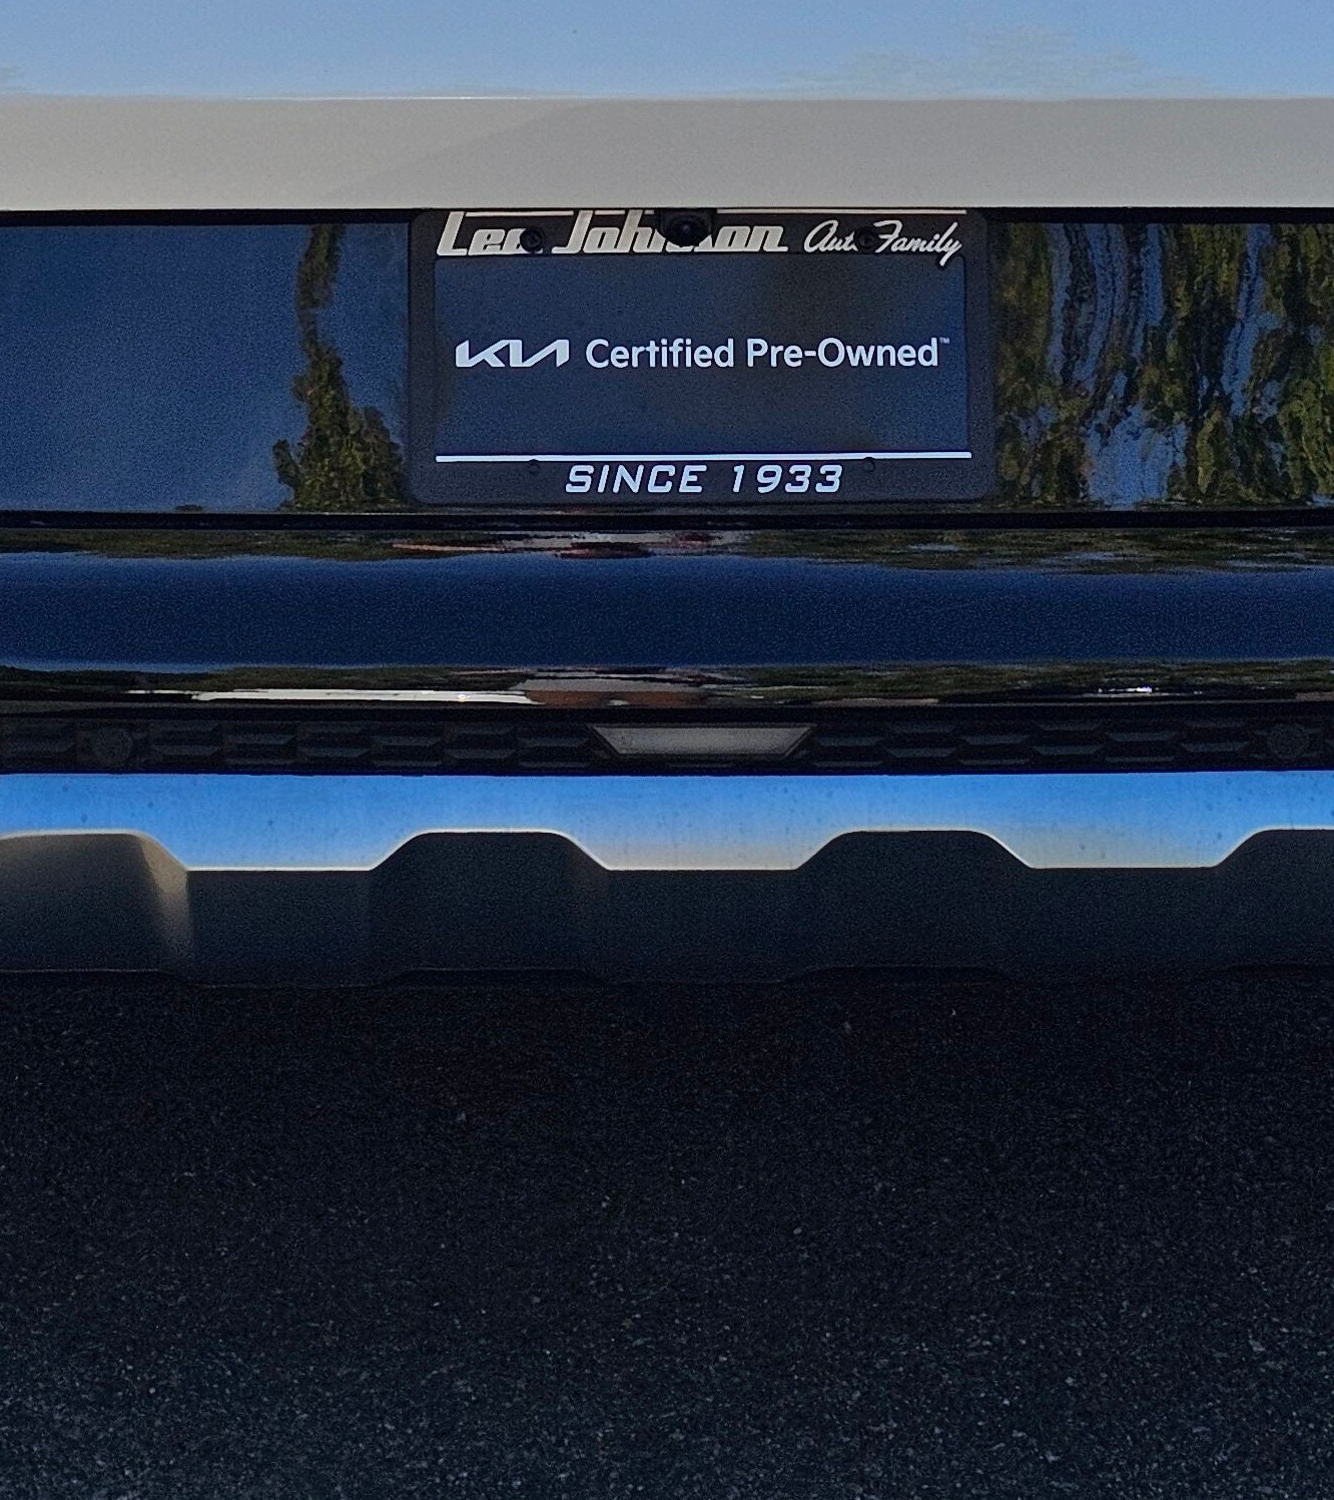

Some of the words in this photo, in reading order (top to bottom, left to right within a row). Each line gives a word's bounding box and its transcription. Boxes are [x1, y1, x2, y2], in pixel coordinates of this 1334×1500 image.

[551, 209, 789, 254] Johon
[803, 219, 860, 253] Aut
[872, 219, 963, 267] Family
[455, 339, 570, 368] KIA
[585, 337, 735, 368] Certified
[566, 464, 707, 493] SINCE
[732, 464, 843, 493] 1933
